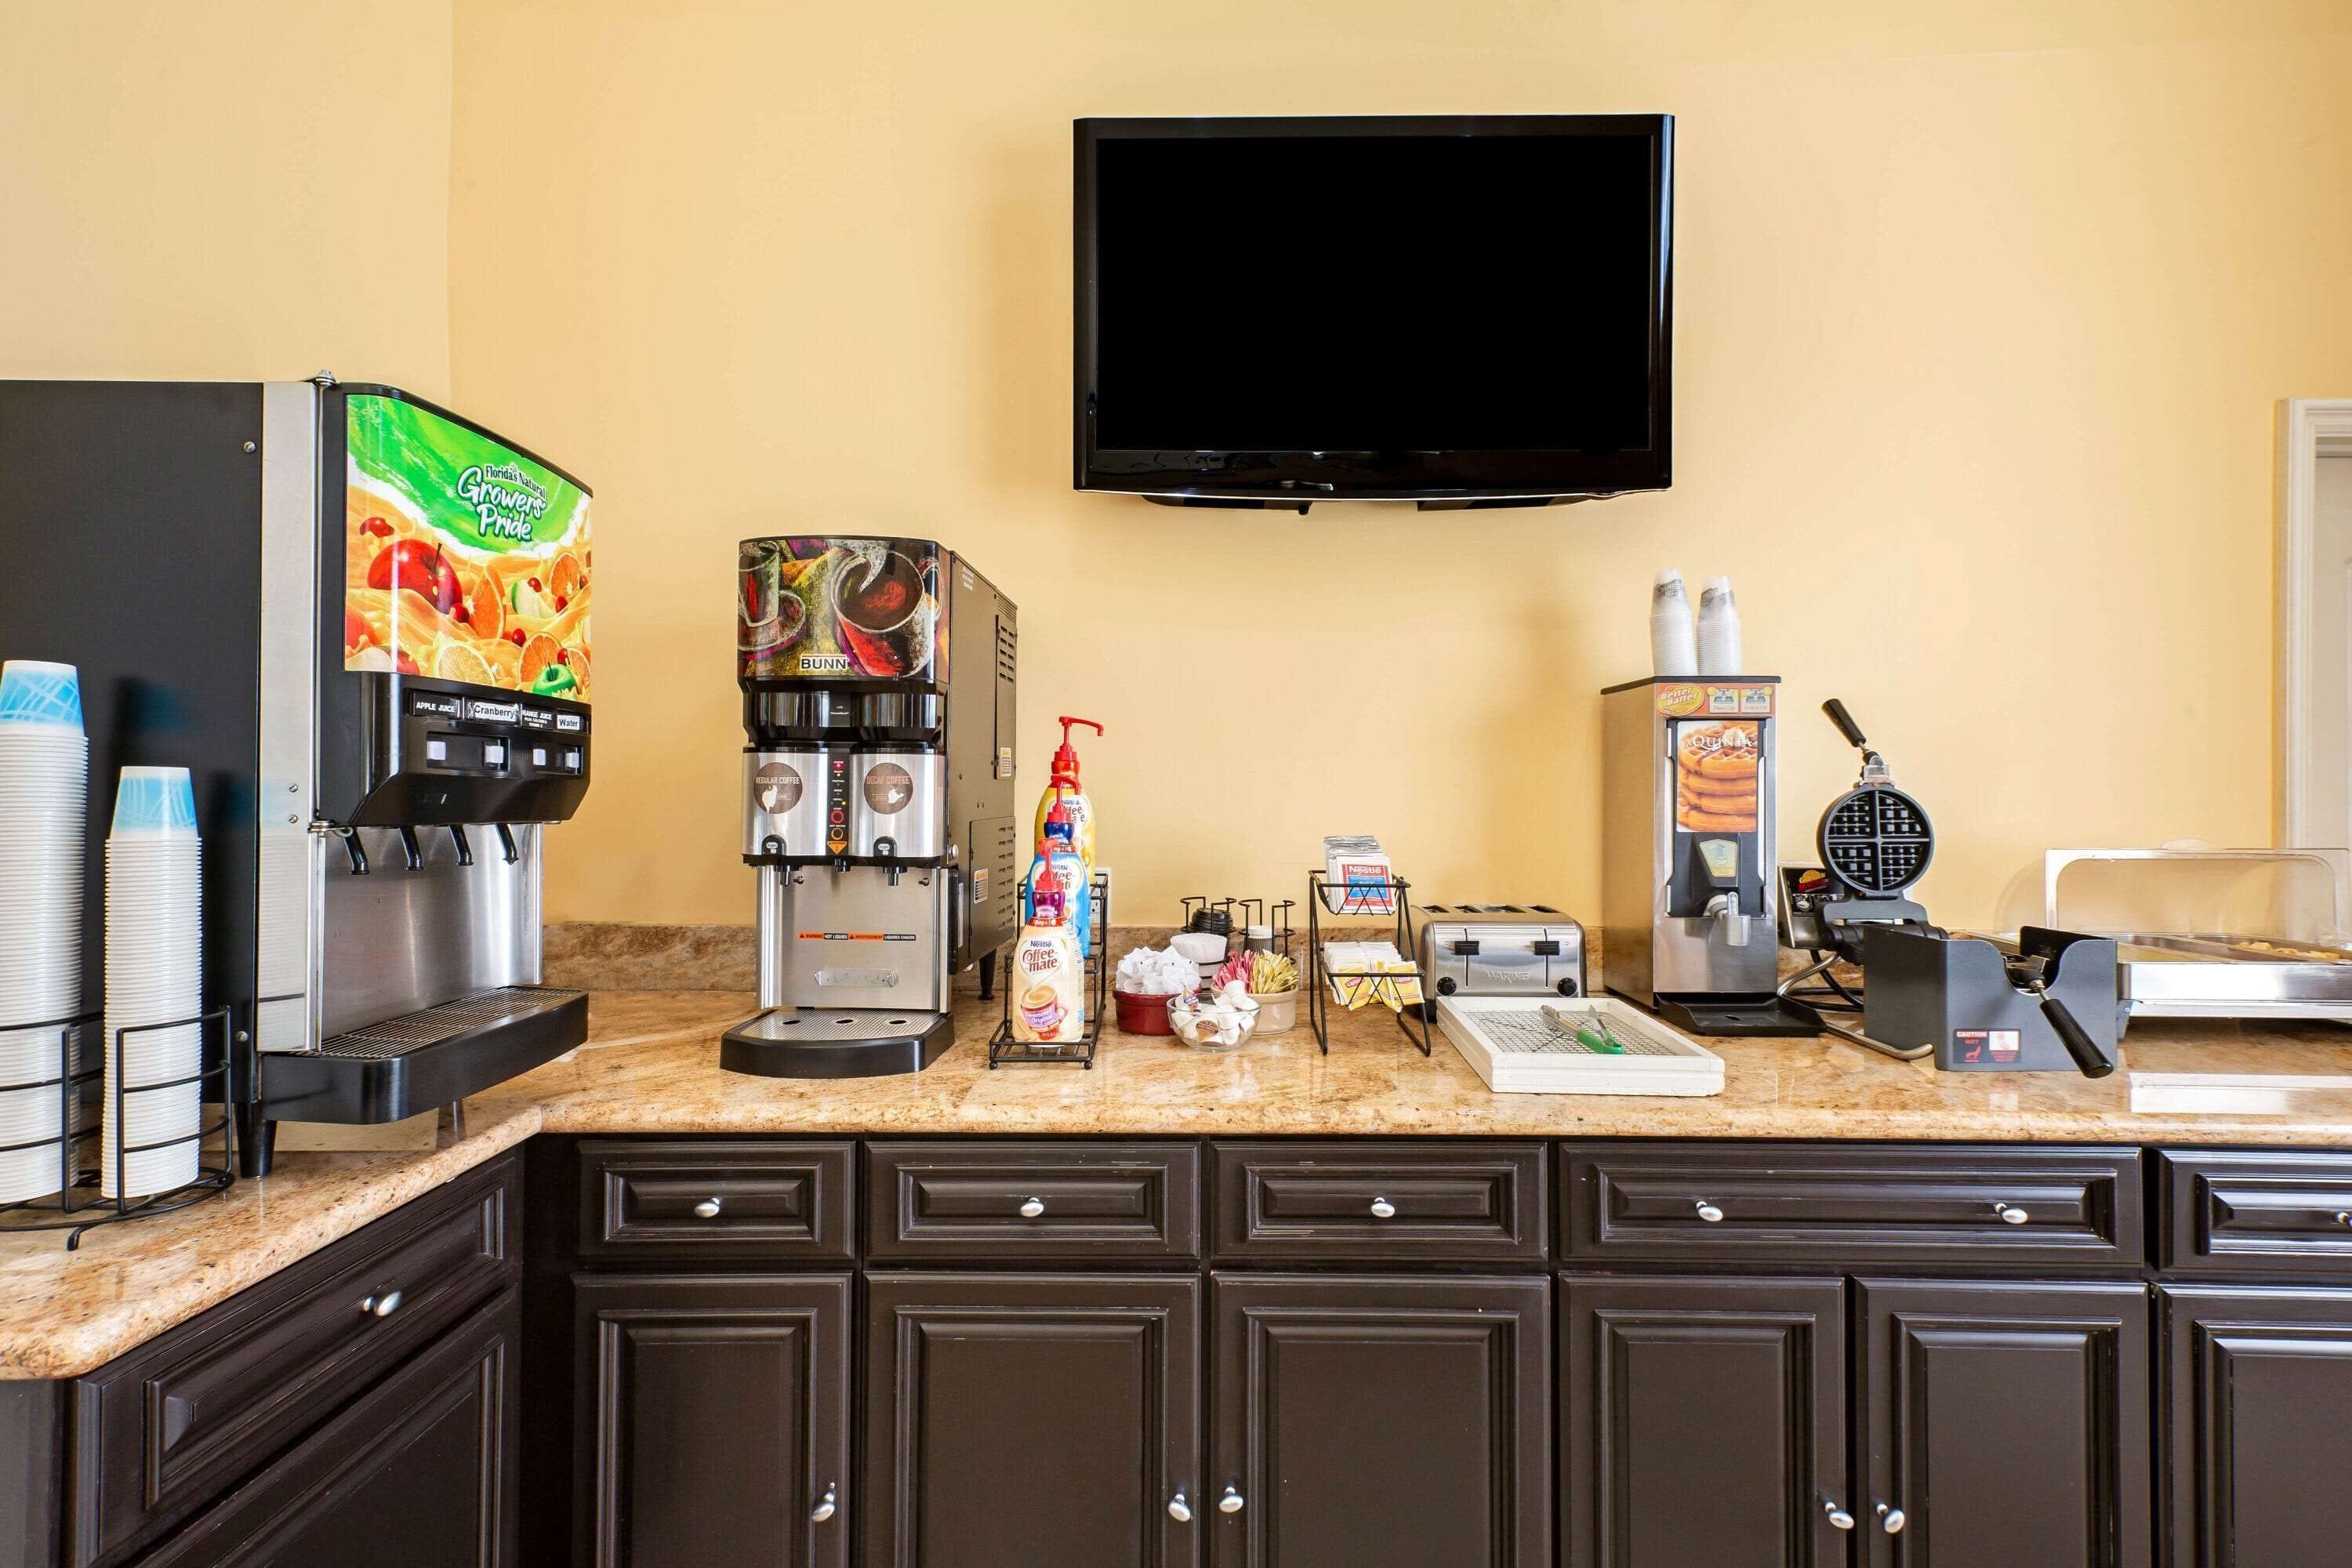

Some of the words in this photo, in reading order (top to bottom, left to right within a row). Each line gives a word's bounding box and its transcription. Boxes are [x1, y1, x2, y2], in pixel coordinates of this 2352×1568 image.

[485, 465, 518, 483] Florida's
[518, 472, 546, 499] Natural
[476, 503, 533, 542] Pride
[800, 658, 846, 670] BUNN
[416, 702, 437, 711] APPLE
[437, 704, 456, 713] JUICE
[474, 704, 515, 719] Cranberry
[521, 710, 539, 718] RANGE
[559, 718, 578, 728] Water
[1029, 958, 1058, 973] mate
